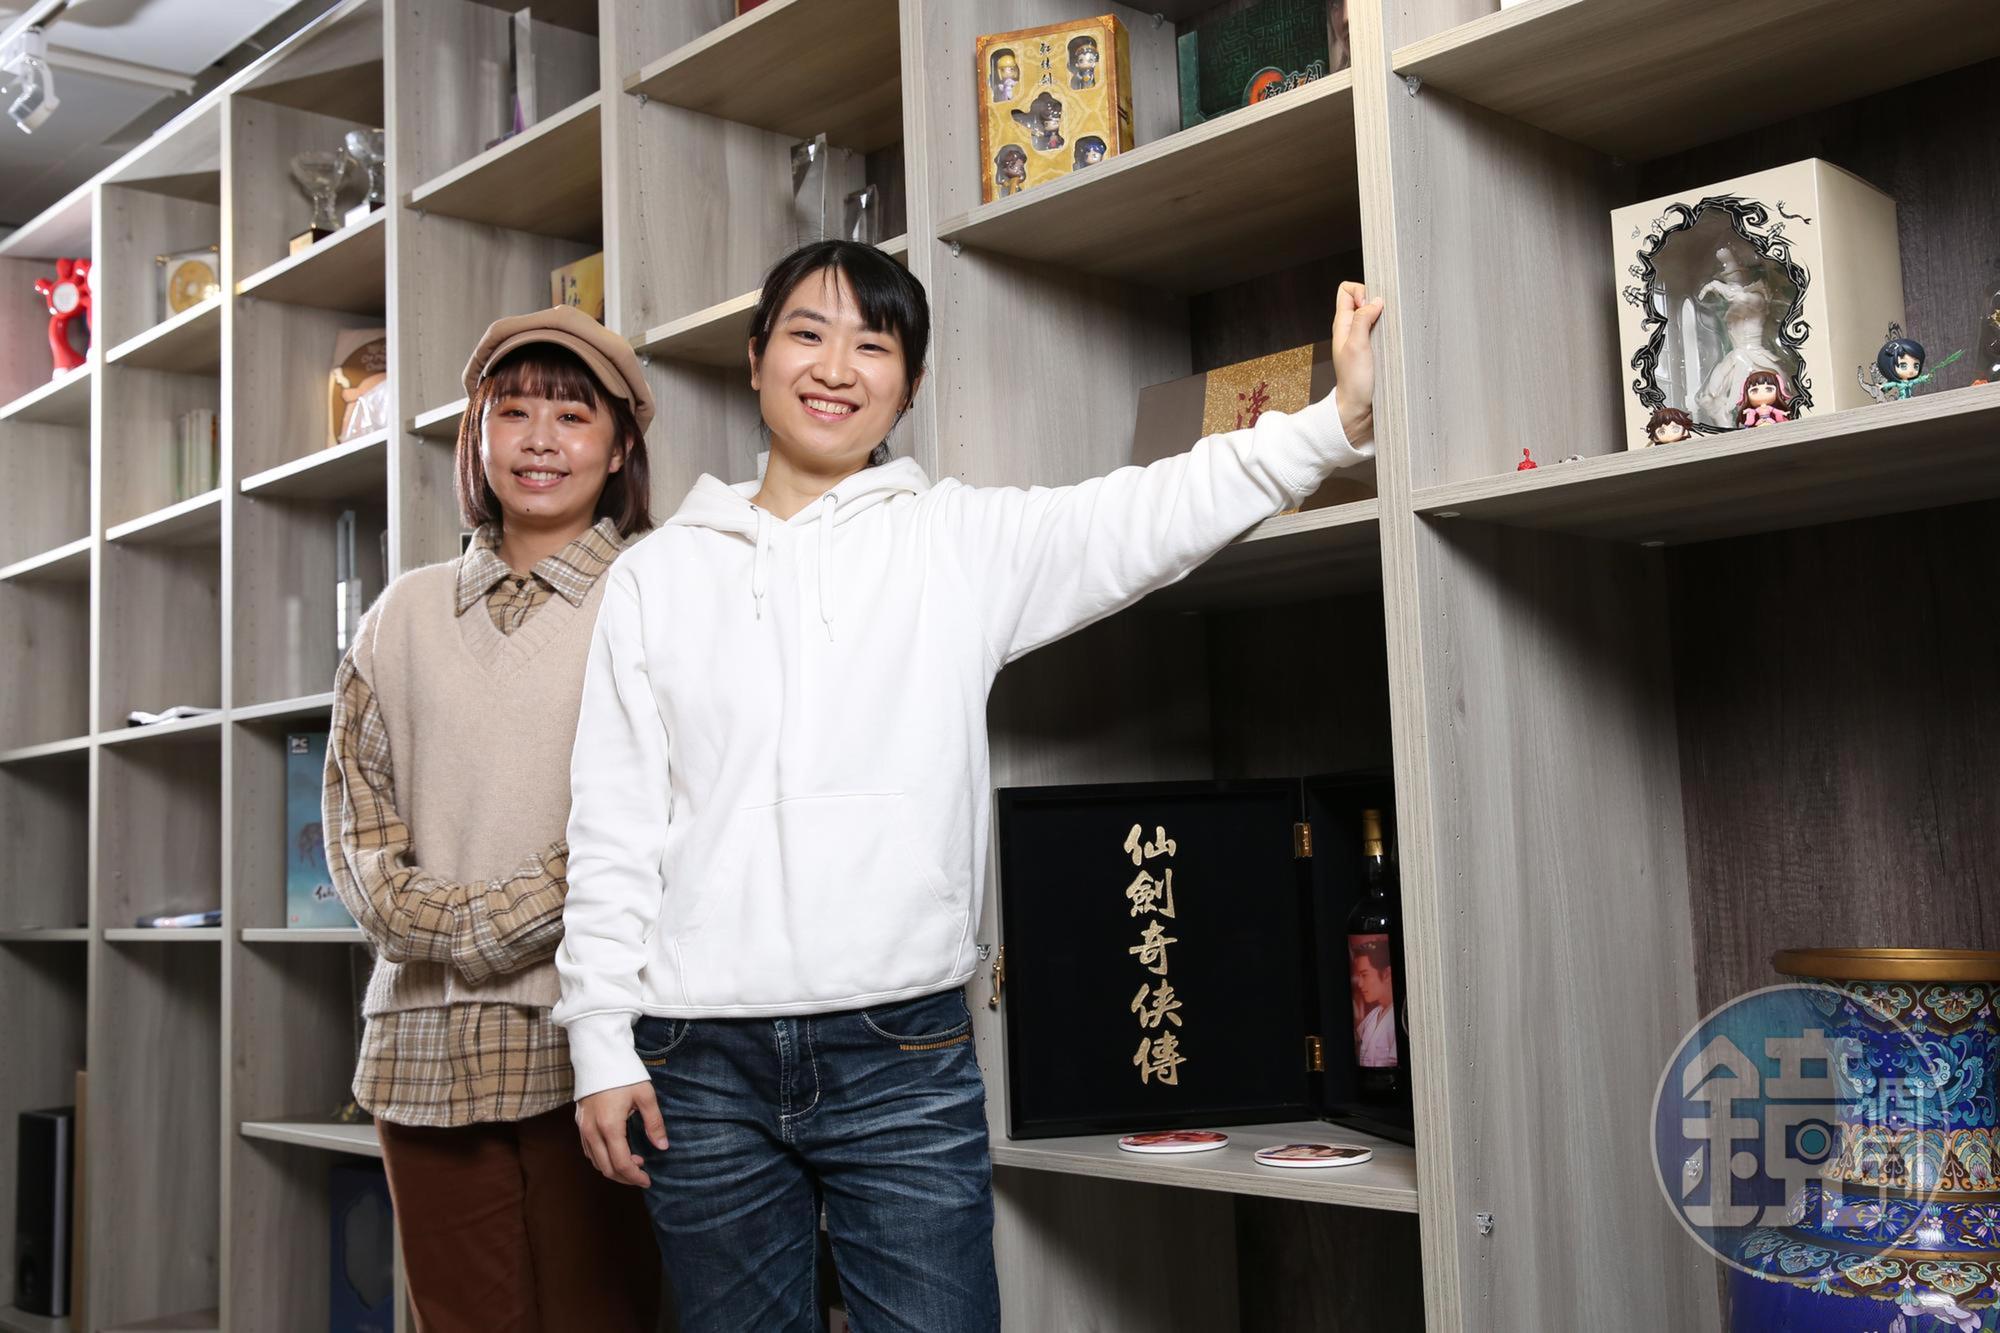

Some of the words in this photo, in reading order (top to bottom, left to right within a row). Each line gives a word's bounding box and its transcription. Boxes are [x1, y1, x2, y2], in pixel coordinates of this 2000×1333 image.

[292, 738, 308, 747] PC
[1123, 823, 1187, 1086] 仙劍奇俠傳
